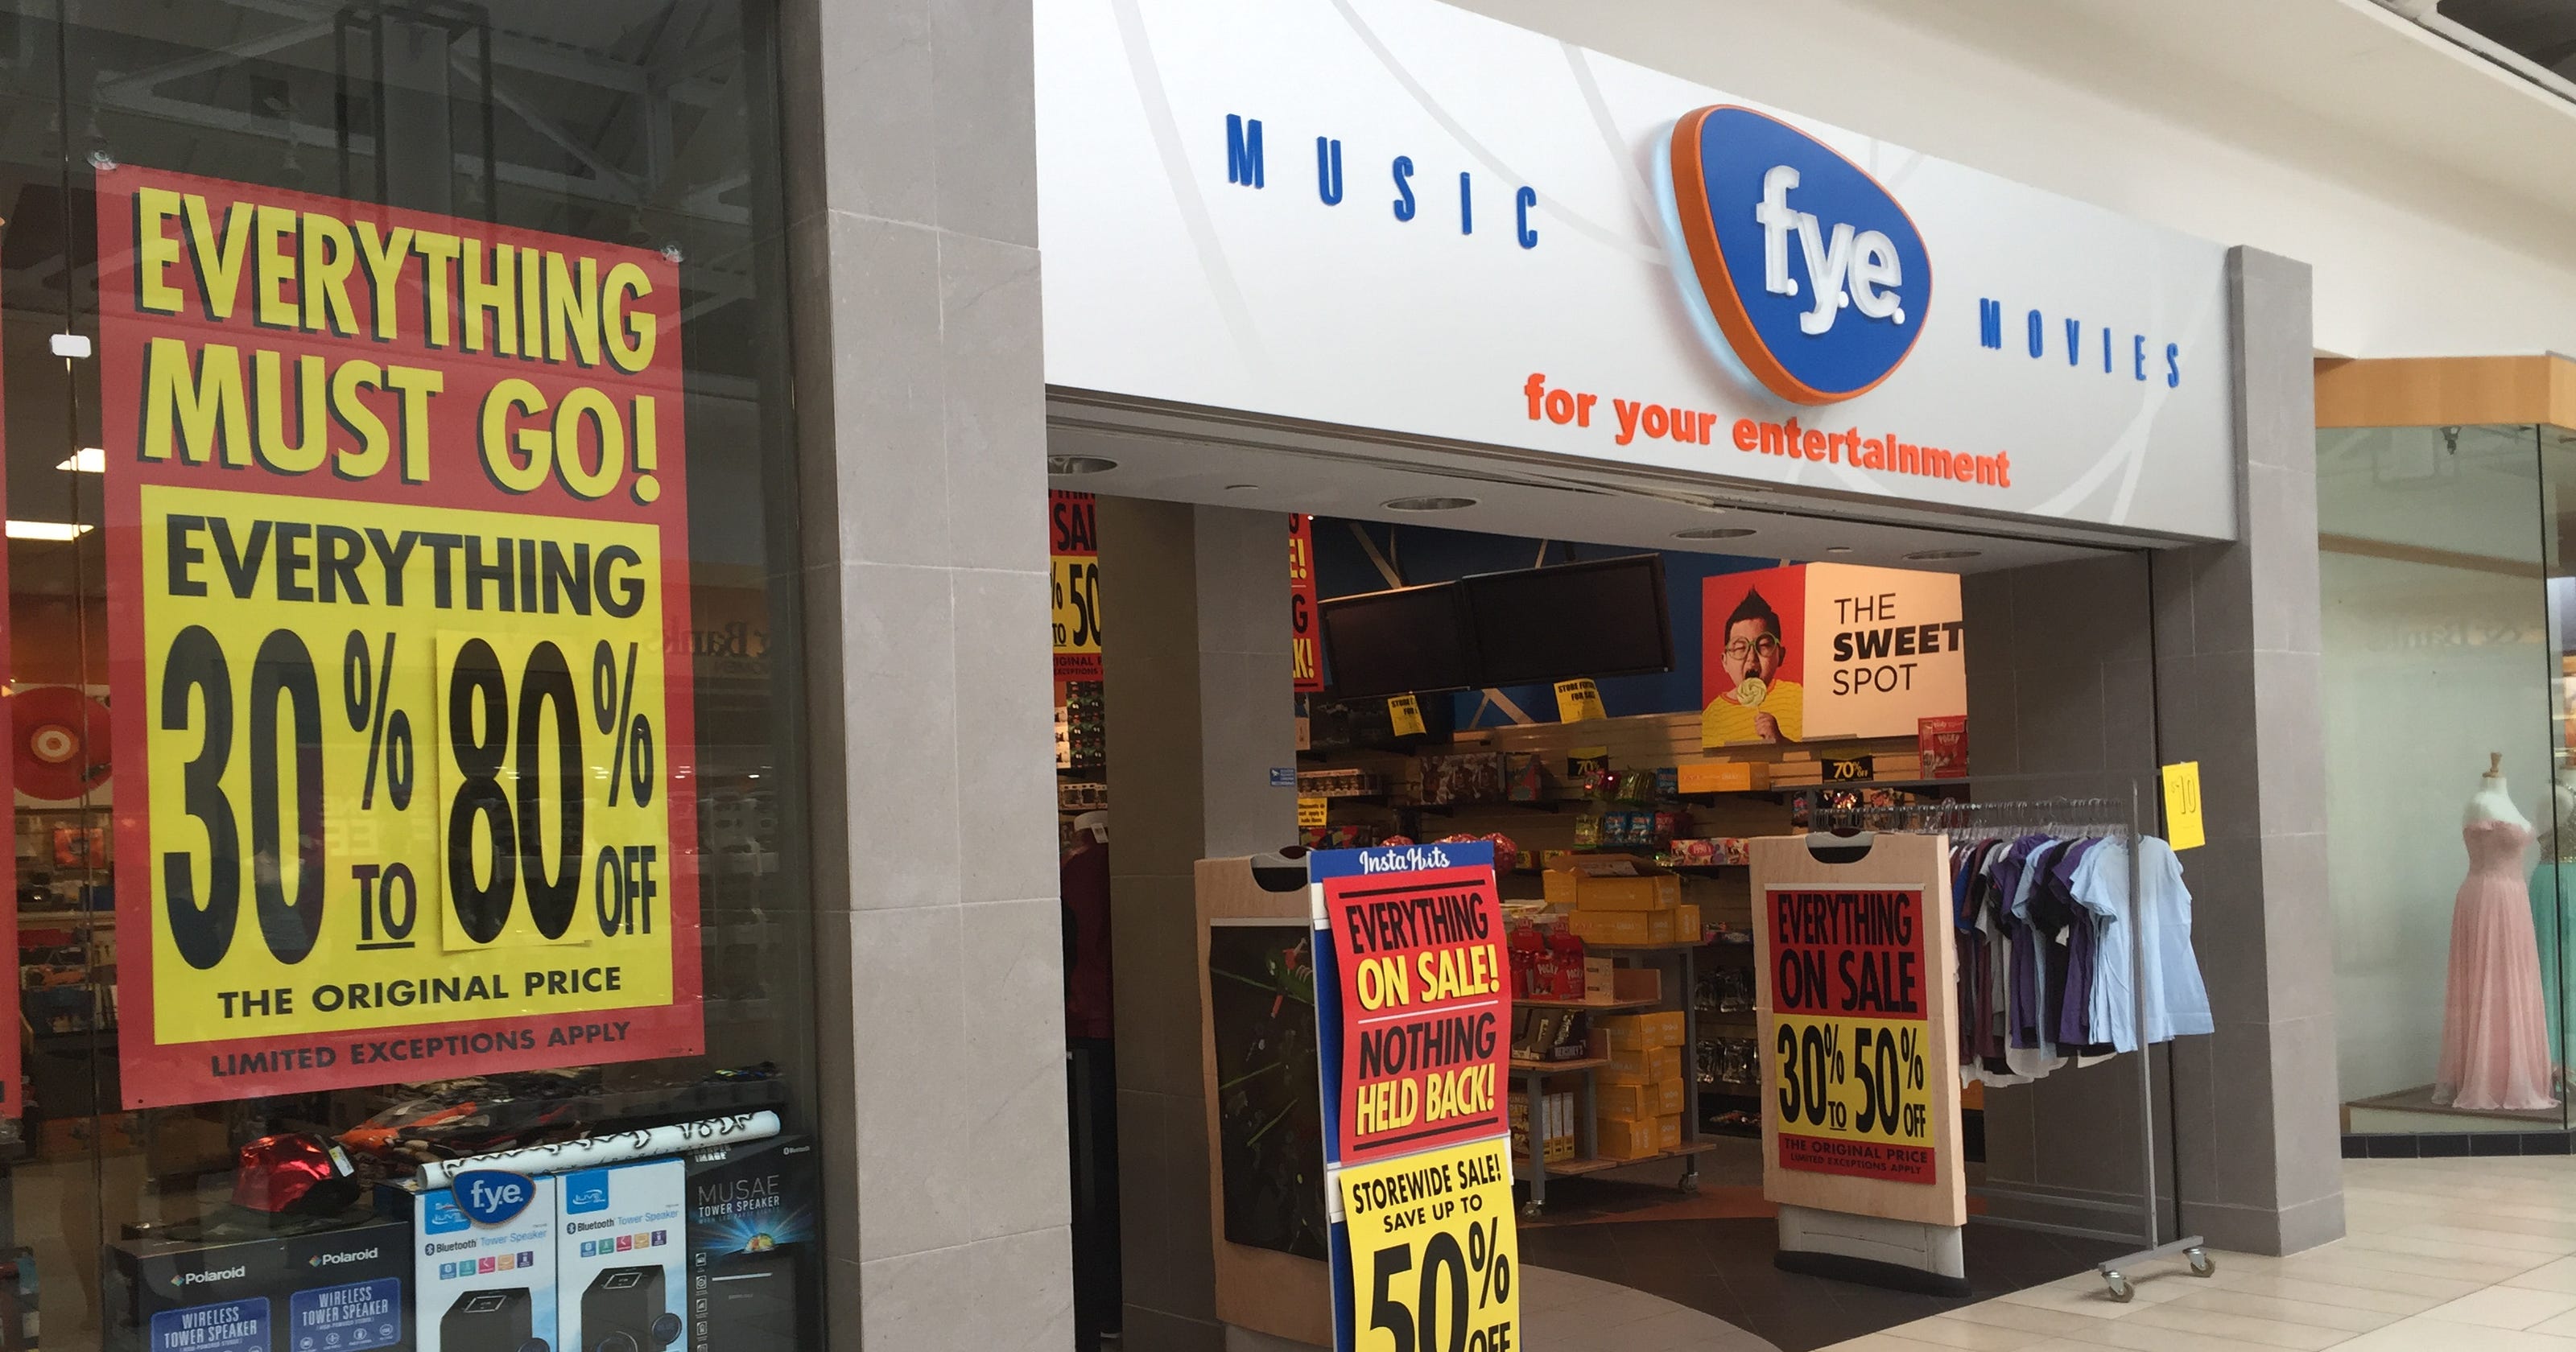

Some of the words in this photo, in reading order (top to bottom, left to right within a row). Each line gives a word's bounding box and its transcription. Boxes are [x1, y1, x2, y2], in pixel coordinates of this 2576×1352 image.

[1225, 113, 1538, 250] MUSIC
[133, 186, 657, 374] EVERYTHING
[1979, 298, 2180, 389] MOVIES
[138, 336, 444, 482] MUST
[481, 378, 661, 505] GO!
[1524, 373, 1597, 428] for
[1612, 395, 1717, 447] your
[1732, 415, 2012, 488] entertainment
[166, 513, 646, 618] EVERYTHING
[1834, 592, 1897, 624] THE
[1833, 620, 1963, 662] SWEET
[1832, 662, 1918, 696] SPOT
[1833, 760, 1862, 779] 70%
[161, 624, 414, 971] 30%
[352, 863, 417, 942] TO
[448, 637, 654, 946] 80%
[596, 846, 657, 937] OFF
[1347, 892, 1489, 955] EVERYTHING
[1777, 892, 1912, 946] EVERYTHING
[217, 988, 293, 1019] THE
[312, 974, 509, 1012] ORIGINAL
[524, 966, 621, 997] PRICE
[1357, 954, 1409, 1012] ON
[1418, 944, 1501, 1004] SALE!
[1779, 948, 1828, 1009] ON
[1838, 950, 1918, 1014] SALE
[211, 1045, 337, 1078] LIMITED
[351, 1028, 536, 1065] EXCEPTIONS
[547, 1021, 630, 1048] APPLY
[1360, 1011, 1496, 1079] NOTHING
[1356, 1079, 1418, 1136] HELD
[1426, 1063, 1495, 1124] BACK!
[1777, 1023, 1845, 1127] 30%
[1827, 1100, 1847, 1129] TO
[1855, 1026, 1923, 1136] 50%
[1904, 1103, 1926, 1138] OFF
[1785, 1138, 1806, 1151] THE
[1811, 1141, 1881, 1160] ORIGINAL
[1886, 1149, 1927, 1164] PRICE
[1790, 1152, 1824, 1164] LIMITED
[1827, 1156, 1887, 1172] EXCEPTIONS
[1890, 1164, 1922, 1175] APPLY
[699, 1174, 779, 1206] MUSAE
[699, 1203, 733, 1218] TOWER
[737, 1196, 780, 1212] SPEAKER
[1352, 1168, 1452, 1215] STOREWIDE
[1457, 1154, 1501, 1189] SALE!
[577, 1219, 615, 1232] Bluetooth
[617, 1215, 643, 1226] Tower
[646, 1210, 679, 1222] Speaker
[1384, 1211, 1426, 1233] SAVE
[1432, 1201, 1455, 1220] UP
[1458, 1193, 1483, 1212] TO
[322, 1247, 378, 1266] Polaroid
[436, 1239, 477, 1253] Bluetooth
[481, 1237, 507, 1247] Tower
[510, 1230, 547, 1243] Speaker
[185, 1266, 246, 1285] Polaroid
[318, 1286, 372, 1309] WIRELESS
[164, 1328, 204, 1350] TOWER
[208, 1319, 258, 1342] SPEAKER
[182, 1306, 239, 1329] WIRELESS
[303, 1309, 341, 1327] TOWER
[343, 1299, 388, 1321] SPEAKER
